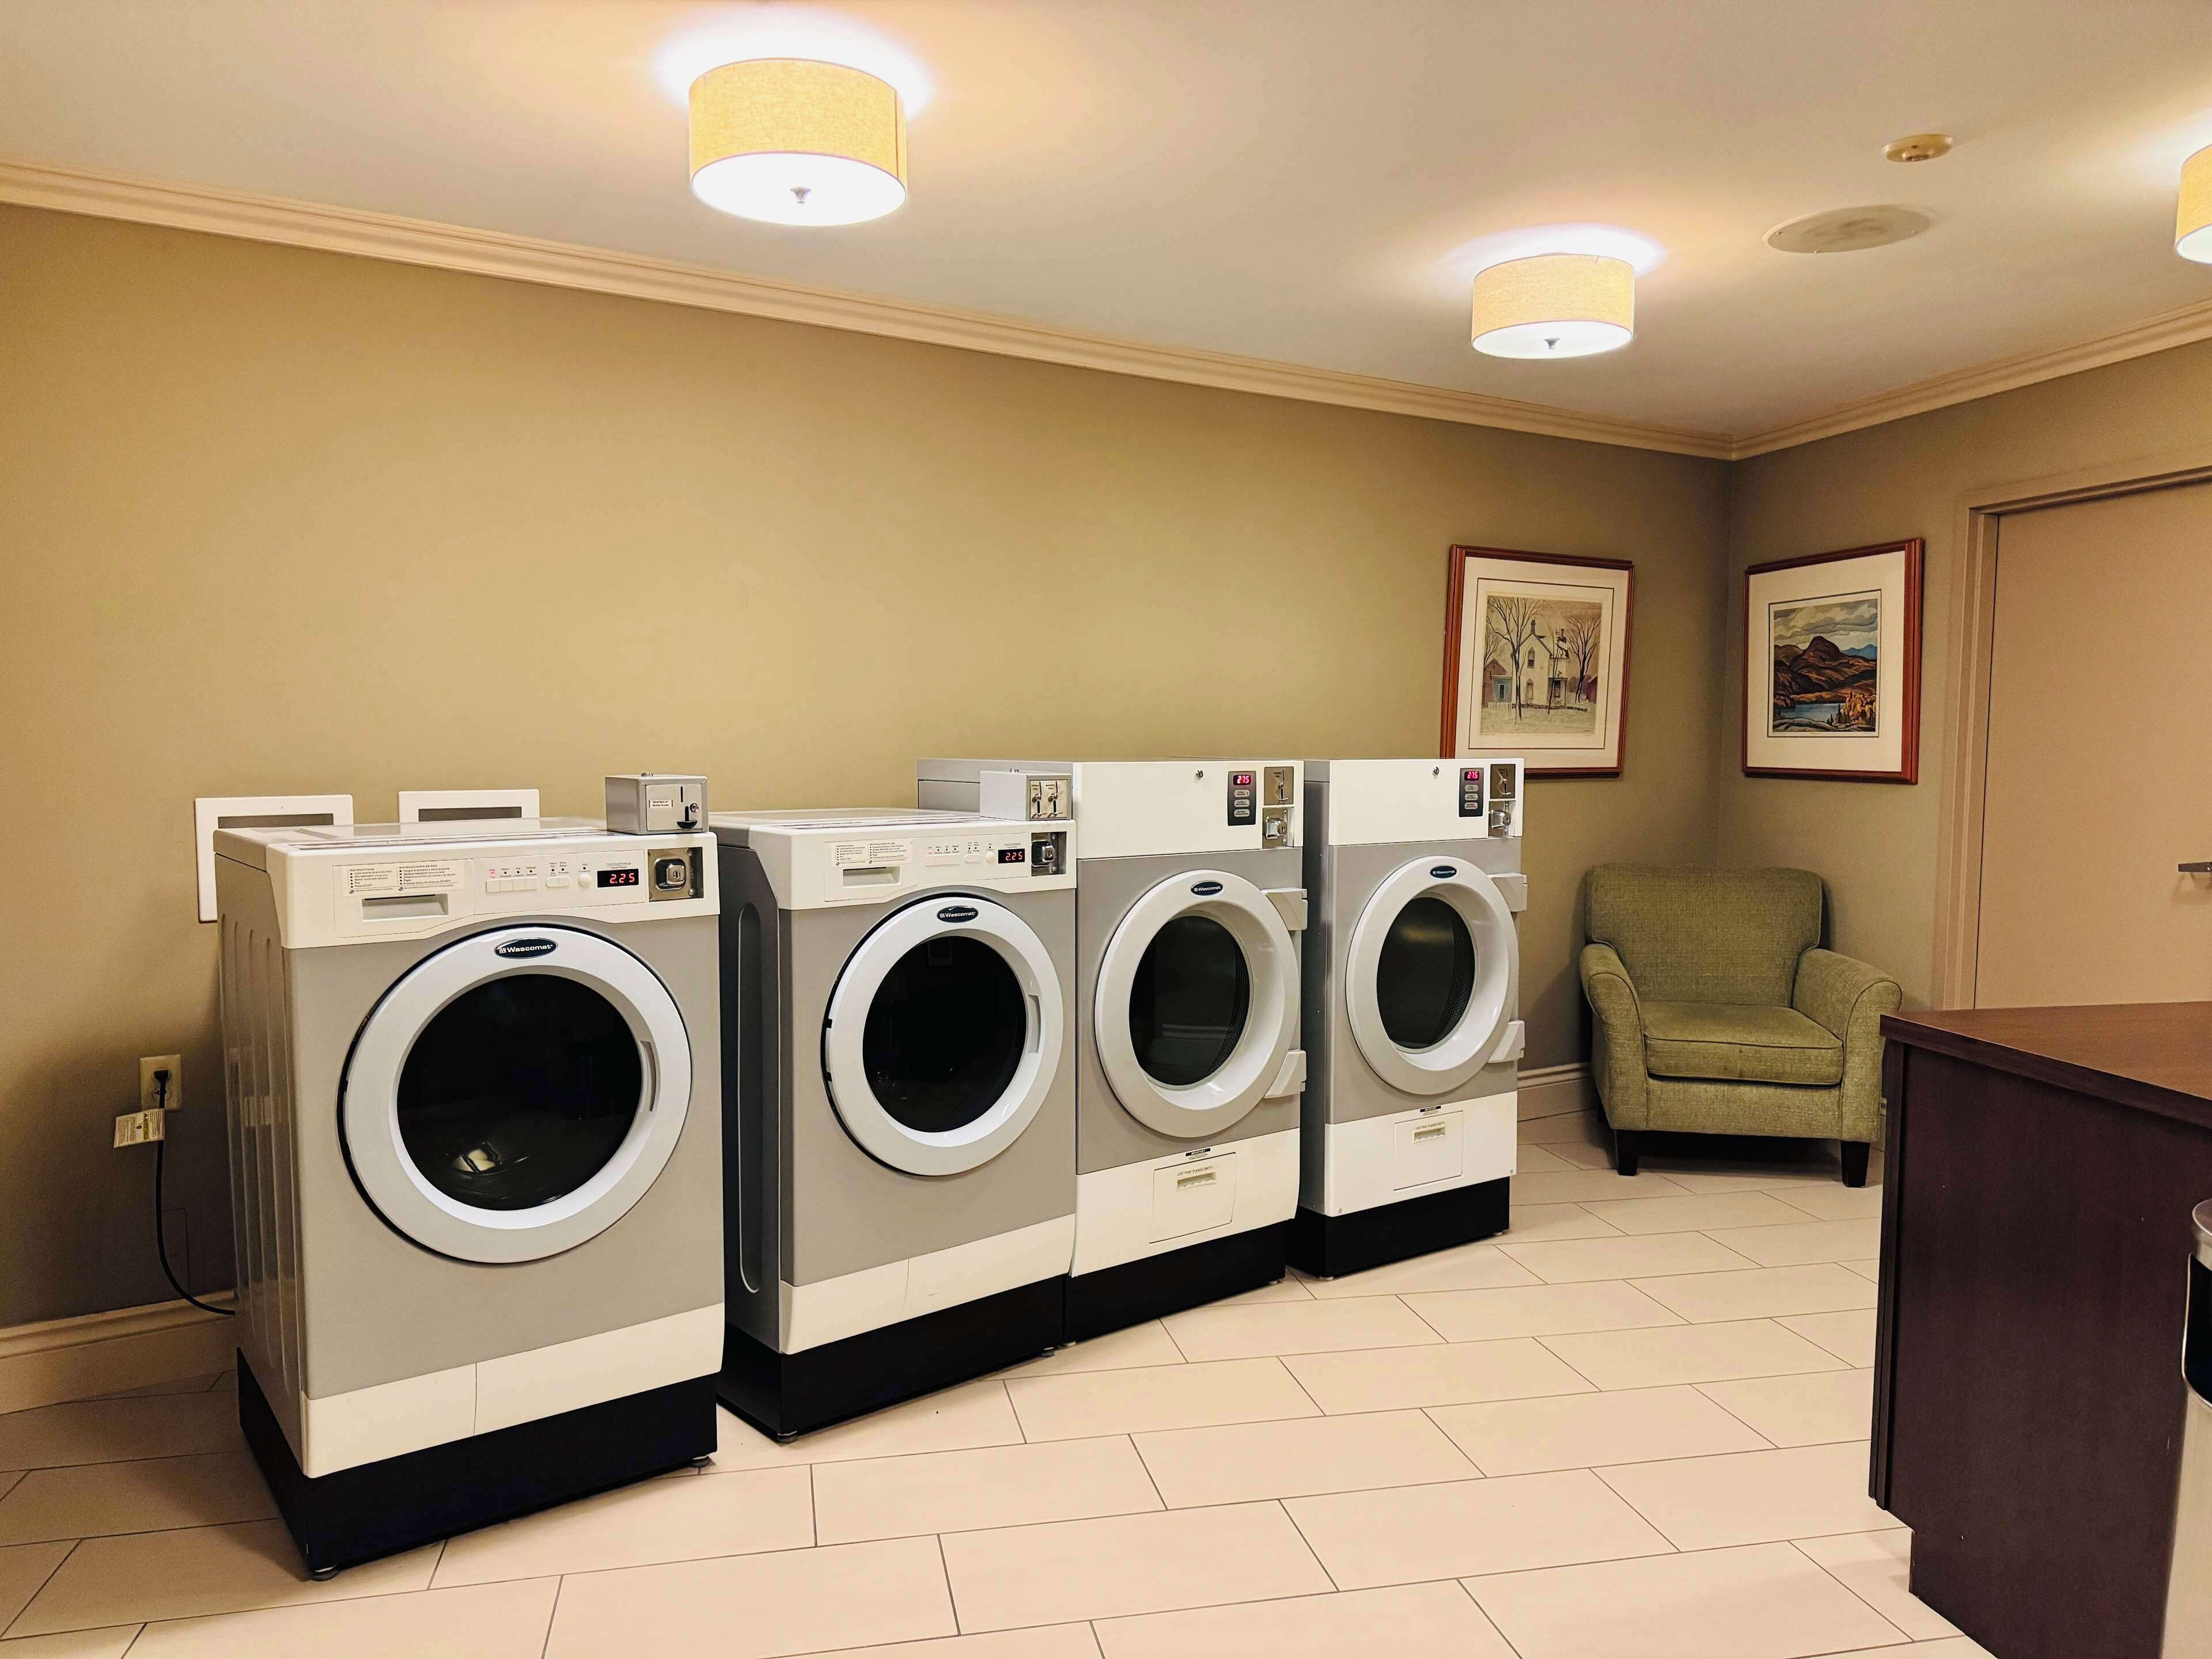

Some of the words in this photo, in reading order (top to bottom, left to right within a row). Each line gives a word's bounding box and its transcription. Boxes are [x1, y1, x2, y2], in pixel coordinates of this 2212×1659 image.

[1005, 851, 1022, 861] 2.25
[609, 873, 635, 884] 2.25
[507, 944, 553, 953] Wascomat
